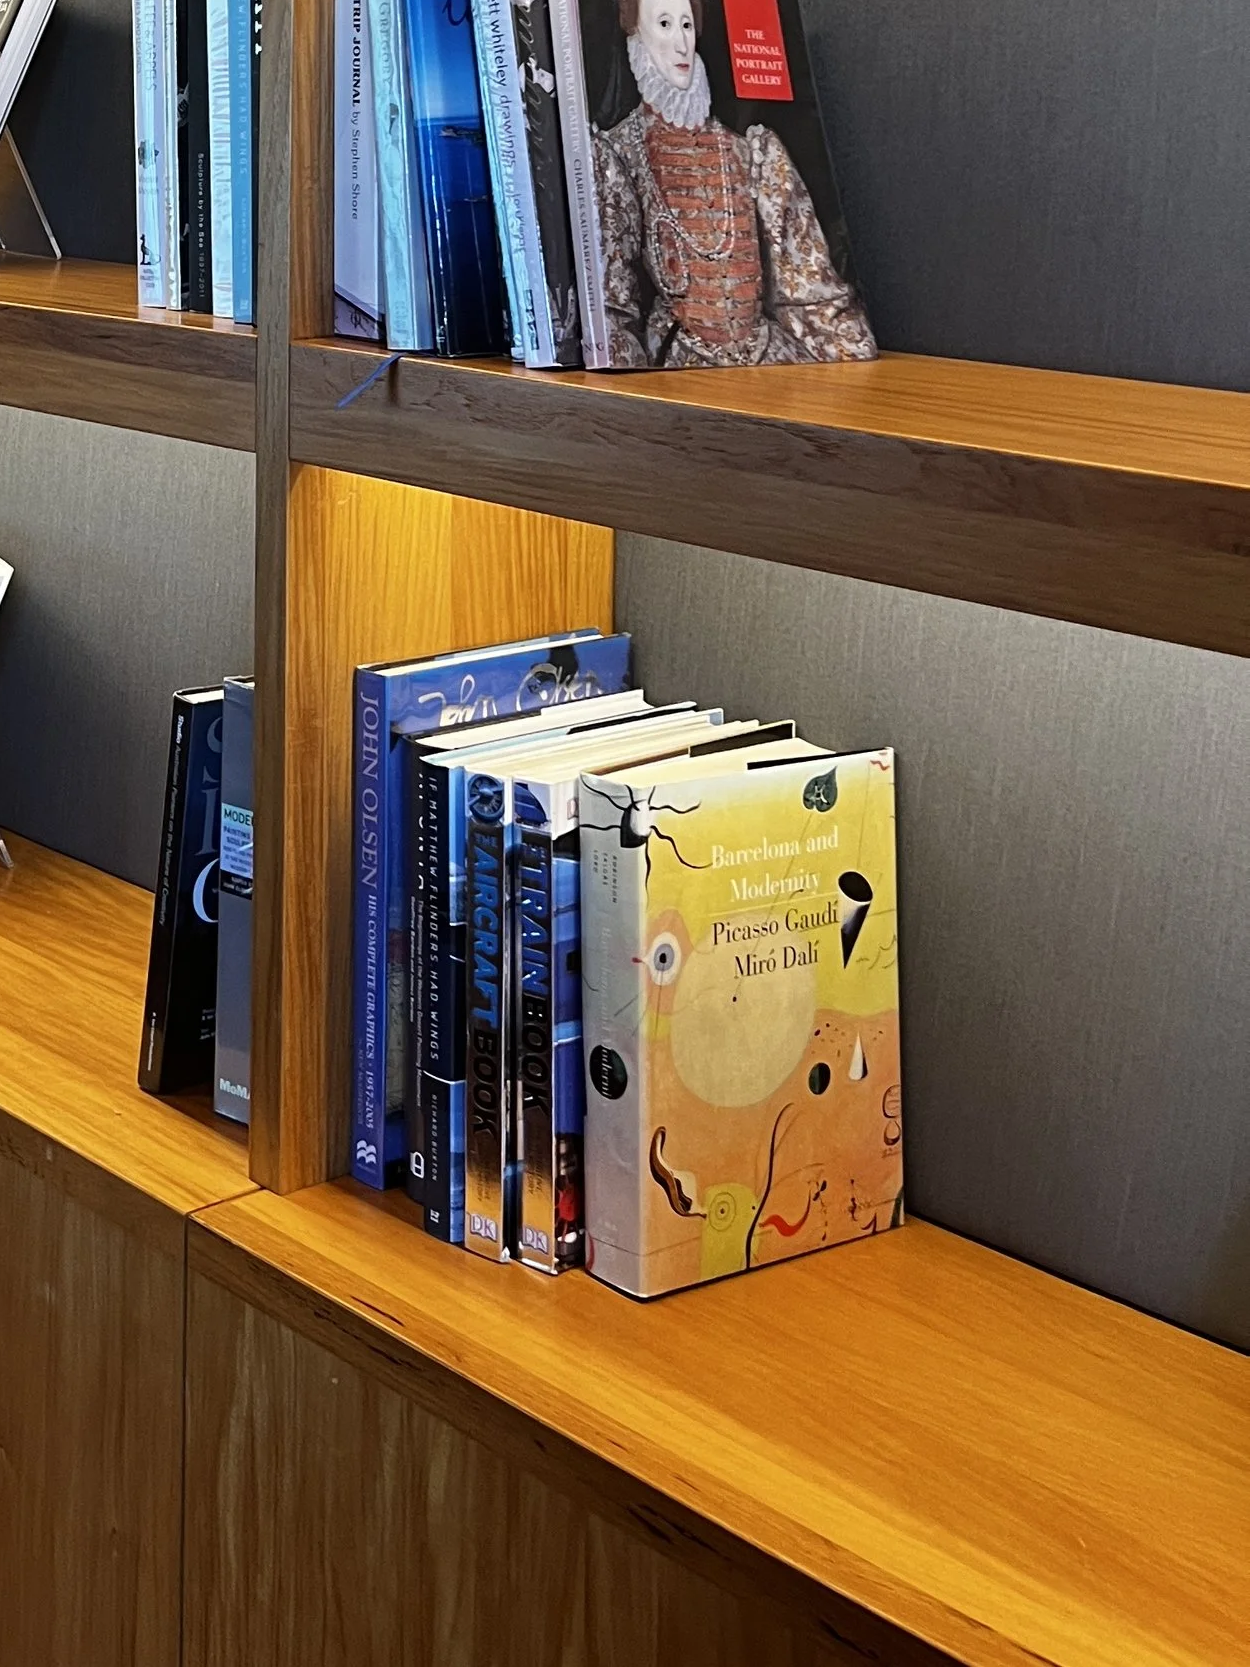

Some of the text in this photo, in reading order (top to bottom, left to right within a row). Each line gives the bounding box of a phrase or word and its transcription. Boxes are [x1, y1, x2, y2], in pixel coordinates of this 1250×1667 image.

[378, 2, 392, 86] GREGORY
[488, 19, 508, 87] whiteley
[733, 43, 782, 57] NATIONAL
[744, 29, 765, 40] THE
[238, 21, 248, 88] FLINDERS
[350, 36, 362, 107] JOURNAL
[735, 57, 783, 71] PORTRAIT
[562, 47, 576, 103] PORTRAIT
[741, 73, 782, 86] GALLERY
[239, 94, 249, 123] HAD
[347, 110, 360, 126] by
[567, 105, 581, 154] GALLERY
[239, 131, 249, 175] WINGS
[349, 128, 361, 180] Stephen
[197, 153, 206, 196] Sculpture
[573, 158, 586, 210] CHARLES
[196, 199, 205, 210] by
[197, 213, 206, 228] the
[349, 183, 361, 220] Shore
[418, 663, 604, 727] John Olsen
[175, 714, 185, 744] Studio
[172, 745, 182, 786] Australian
[429, 776, 438, 791] IF
[169, 787, 179, 819] Painters
[166, 833, 174, 848] the
[168, 820, 175, 833] on
[429, 799, 438, 878] MATTHEW
[163, 849, 173, 876] Nature
[711, 825, 839, 869] Barcelona and
[730, 869, 821, 903] Modernity
[158, 888, 169, 926] Creativity
[360, 691, 380, 1129] JOHN OLSEN HIS COMPLETE GRAPHICS 1957-2005
[430, 884, 439, 962] FLINDERS
[712, 900, 839, 946] Picasso Gaudí
[734, 940, 820, 979] Miró Dalí
[430, 969, 439, 1001] HAD
[471, 847, 499, 1135] AIRCRAFT BOOK
[521, 859, 549, 1113] TRAIN BOOK
[430, 1010, 439, 1061] WINGS
[470, 1213, 498, 1244] DK
[522, 1226, 549, 1256] DK
